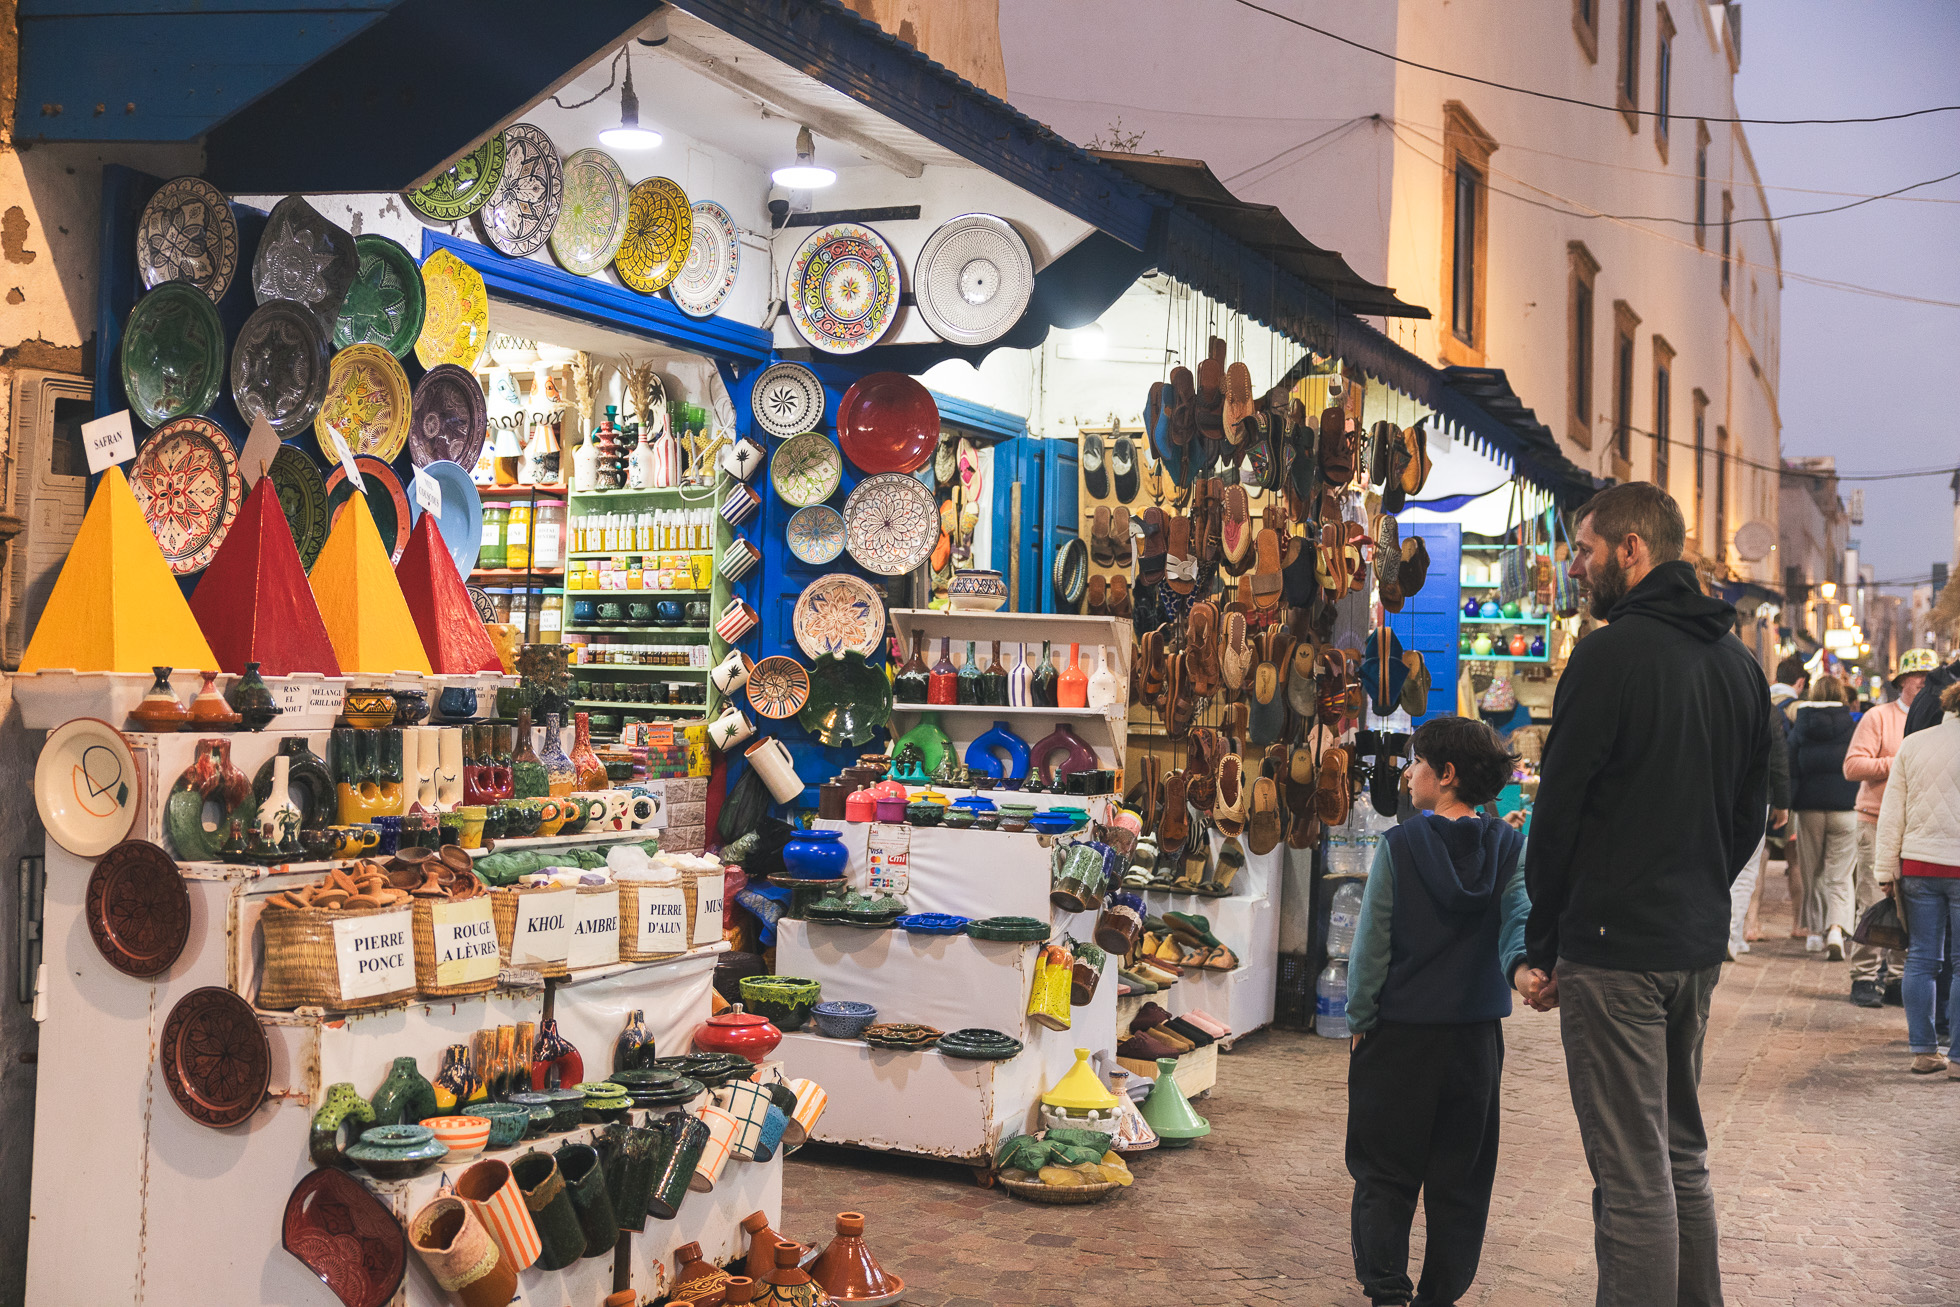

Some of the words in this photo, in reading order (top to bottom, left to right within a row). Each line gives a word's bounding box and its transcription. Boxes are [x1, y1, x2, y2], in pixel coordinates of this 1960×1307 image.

[94, 431, 122, 450] SAFRAN
[888, 854, 906, 862] cmi
[650, 904, 682, 916] PIERRE
[453, 920, 491, 940] ROUGE
[527, 914, 565, 933] KHOL
[574, 916, 618, 935] AMBRE
[648, 921, 682, 934] D'ALUN
[354, 931, 405, 952] PIERRE
[443, 950, 453, 962] A
[456, 941, 497, 960] LÈVRES
[358, 954, 404, 974] PONCE
